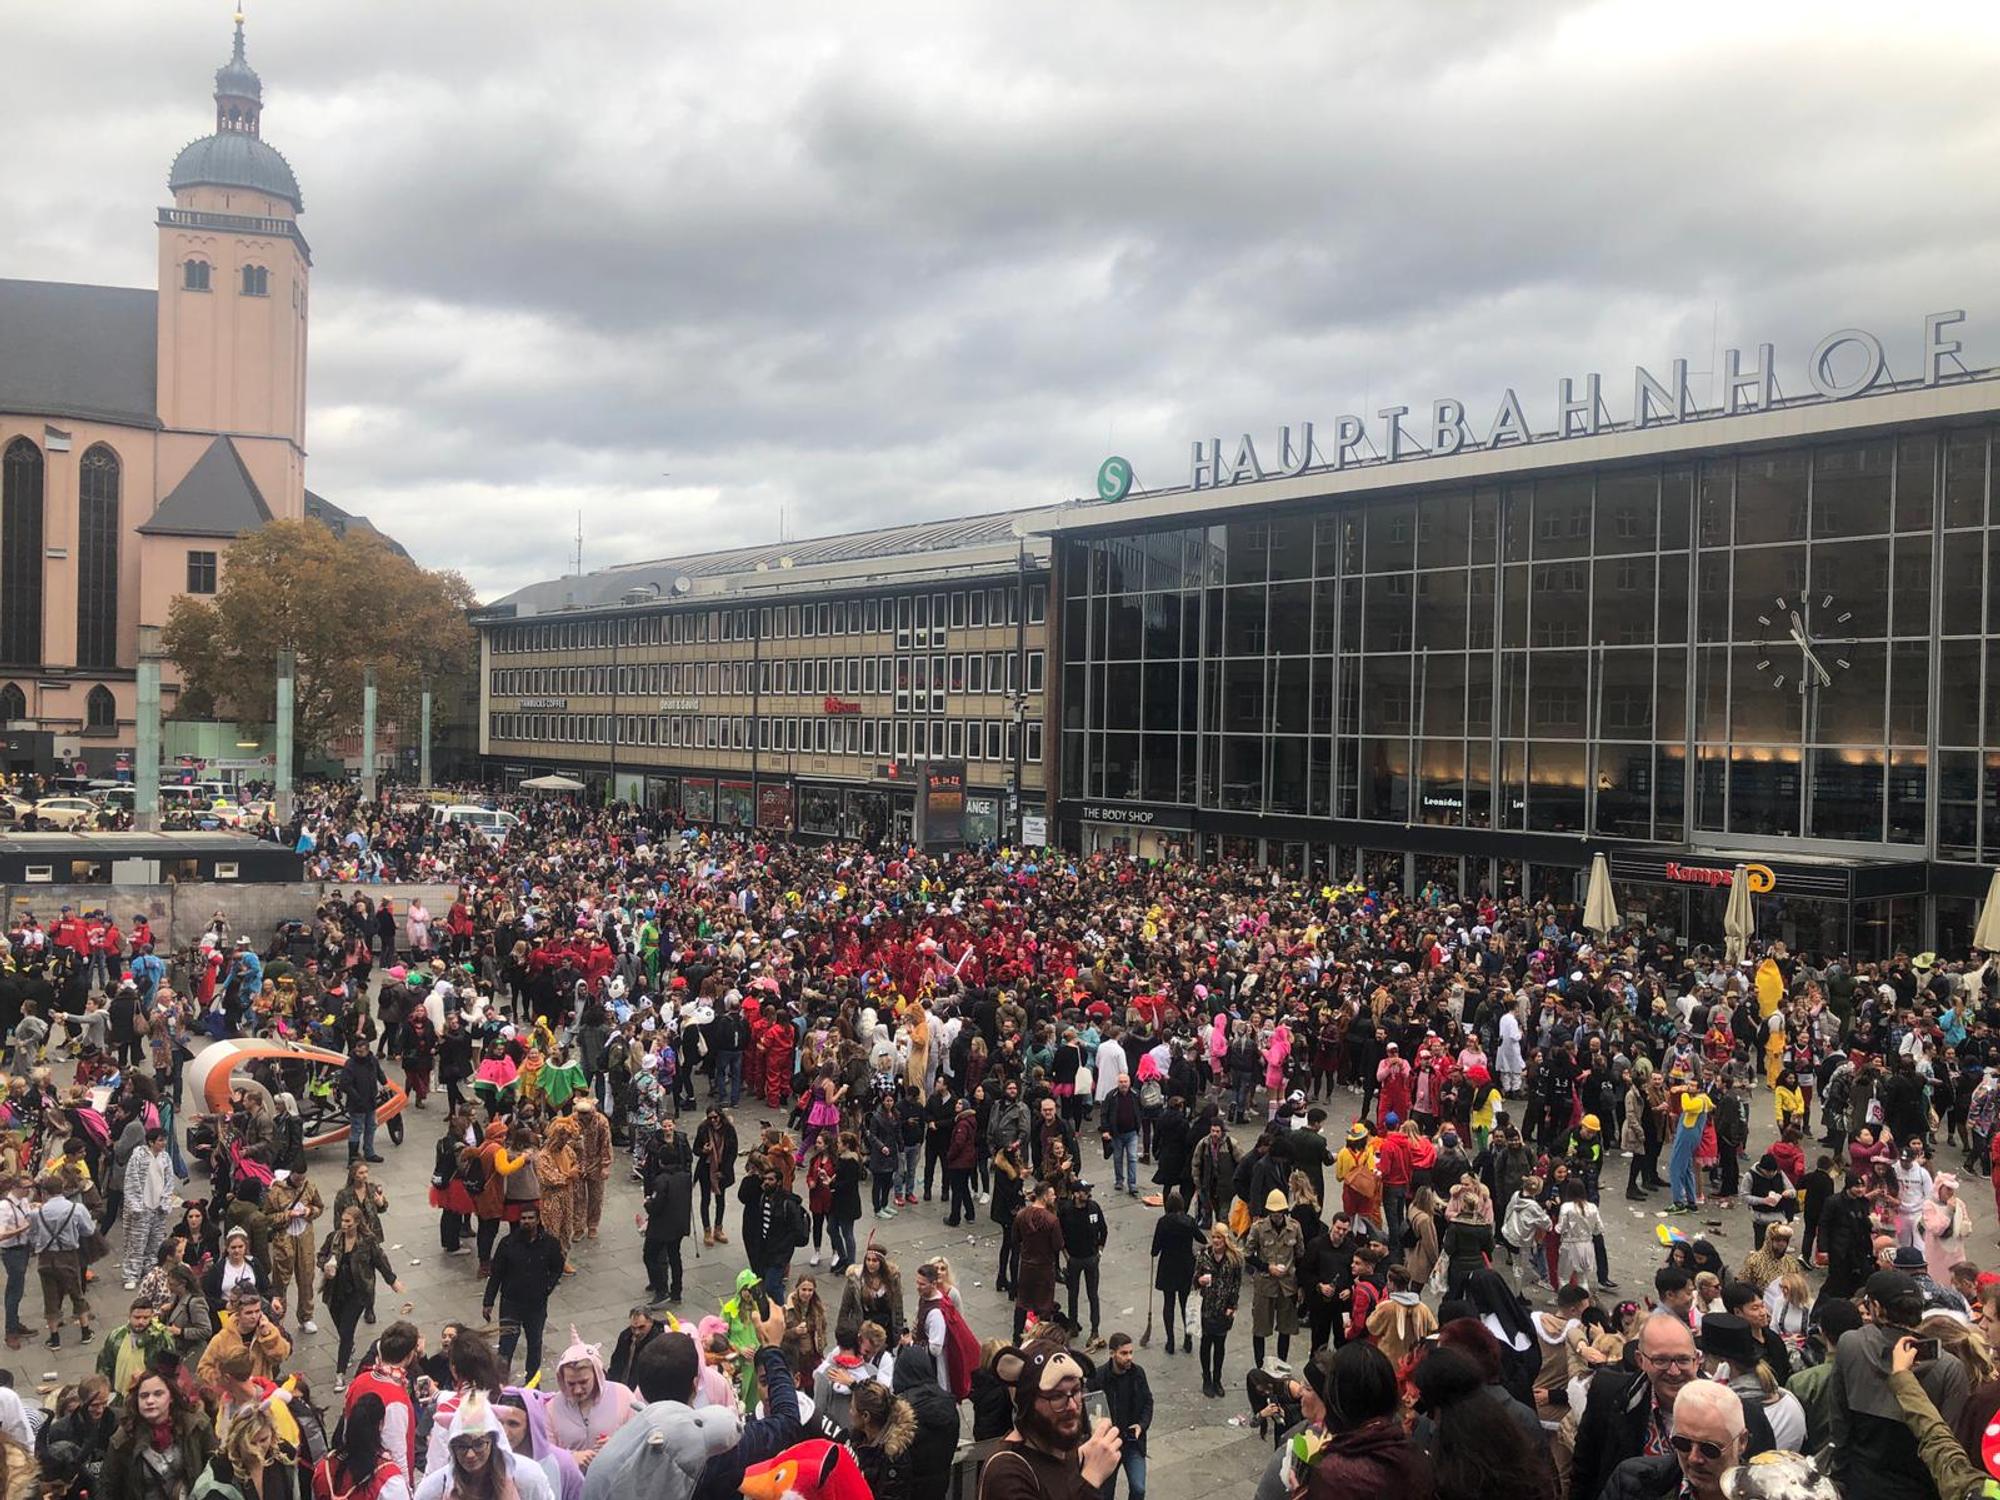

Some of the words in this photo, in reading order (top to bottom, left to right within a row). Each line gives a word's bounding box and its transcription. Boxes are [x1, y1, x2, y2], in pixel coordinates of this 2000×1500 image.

[1190, 310, 1966, 489] HAUPTBAHNHOF
[1104, 463, 1122, 496] S
[545, 699, 566, 708] COFFEE
[681, 698, 699, 710] david
[1424, 796, 1462, 807] Leonidas
[1083, 807, 1100, 819] THE
[1102, 808, 1127, 820] BODY
[1128, 811, 1153, 823] SHOP
[1665, 862, 1734, 888] Kamps
